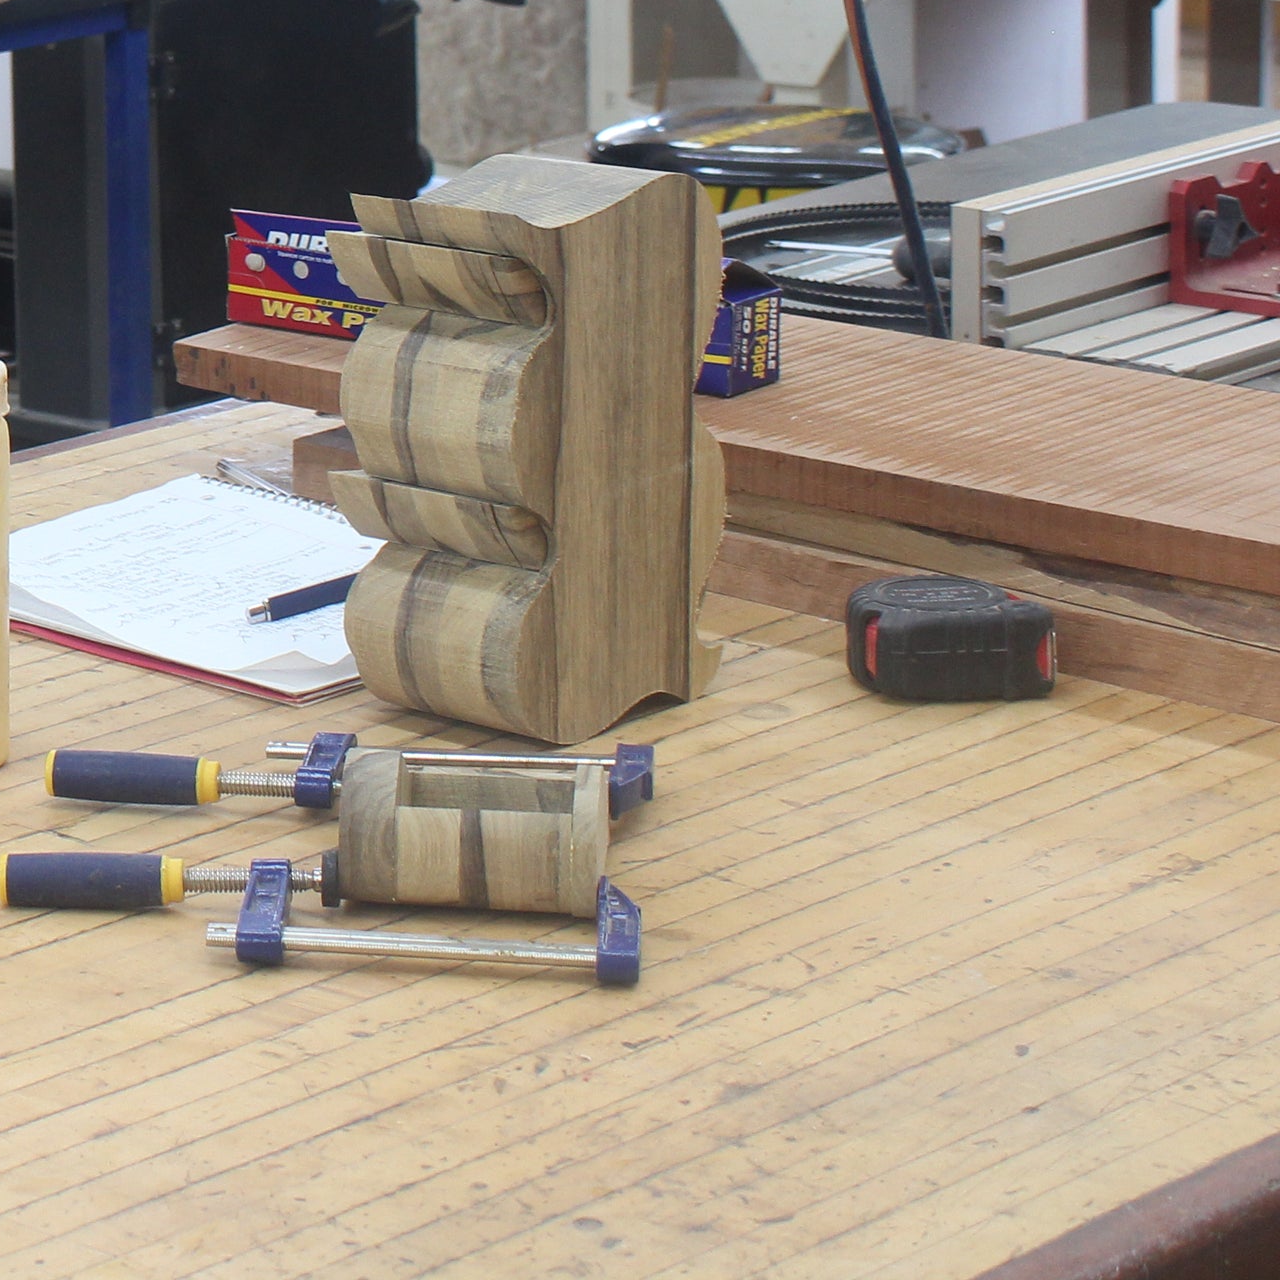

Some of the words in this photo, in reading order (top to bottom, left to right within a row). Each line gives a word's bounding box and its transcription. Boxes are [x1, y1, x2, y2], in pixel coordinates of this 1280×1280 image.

[261, 298, 333, 326] Wax
[342, 303, 381, 313] MICROW
[743, 306, 751, 333] 50
[755, 298, 769, 331] Wax
[767, 297, 778, 369] DURABLE
[751, 334, 769, 379] Paper
